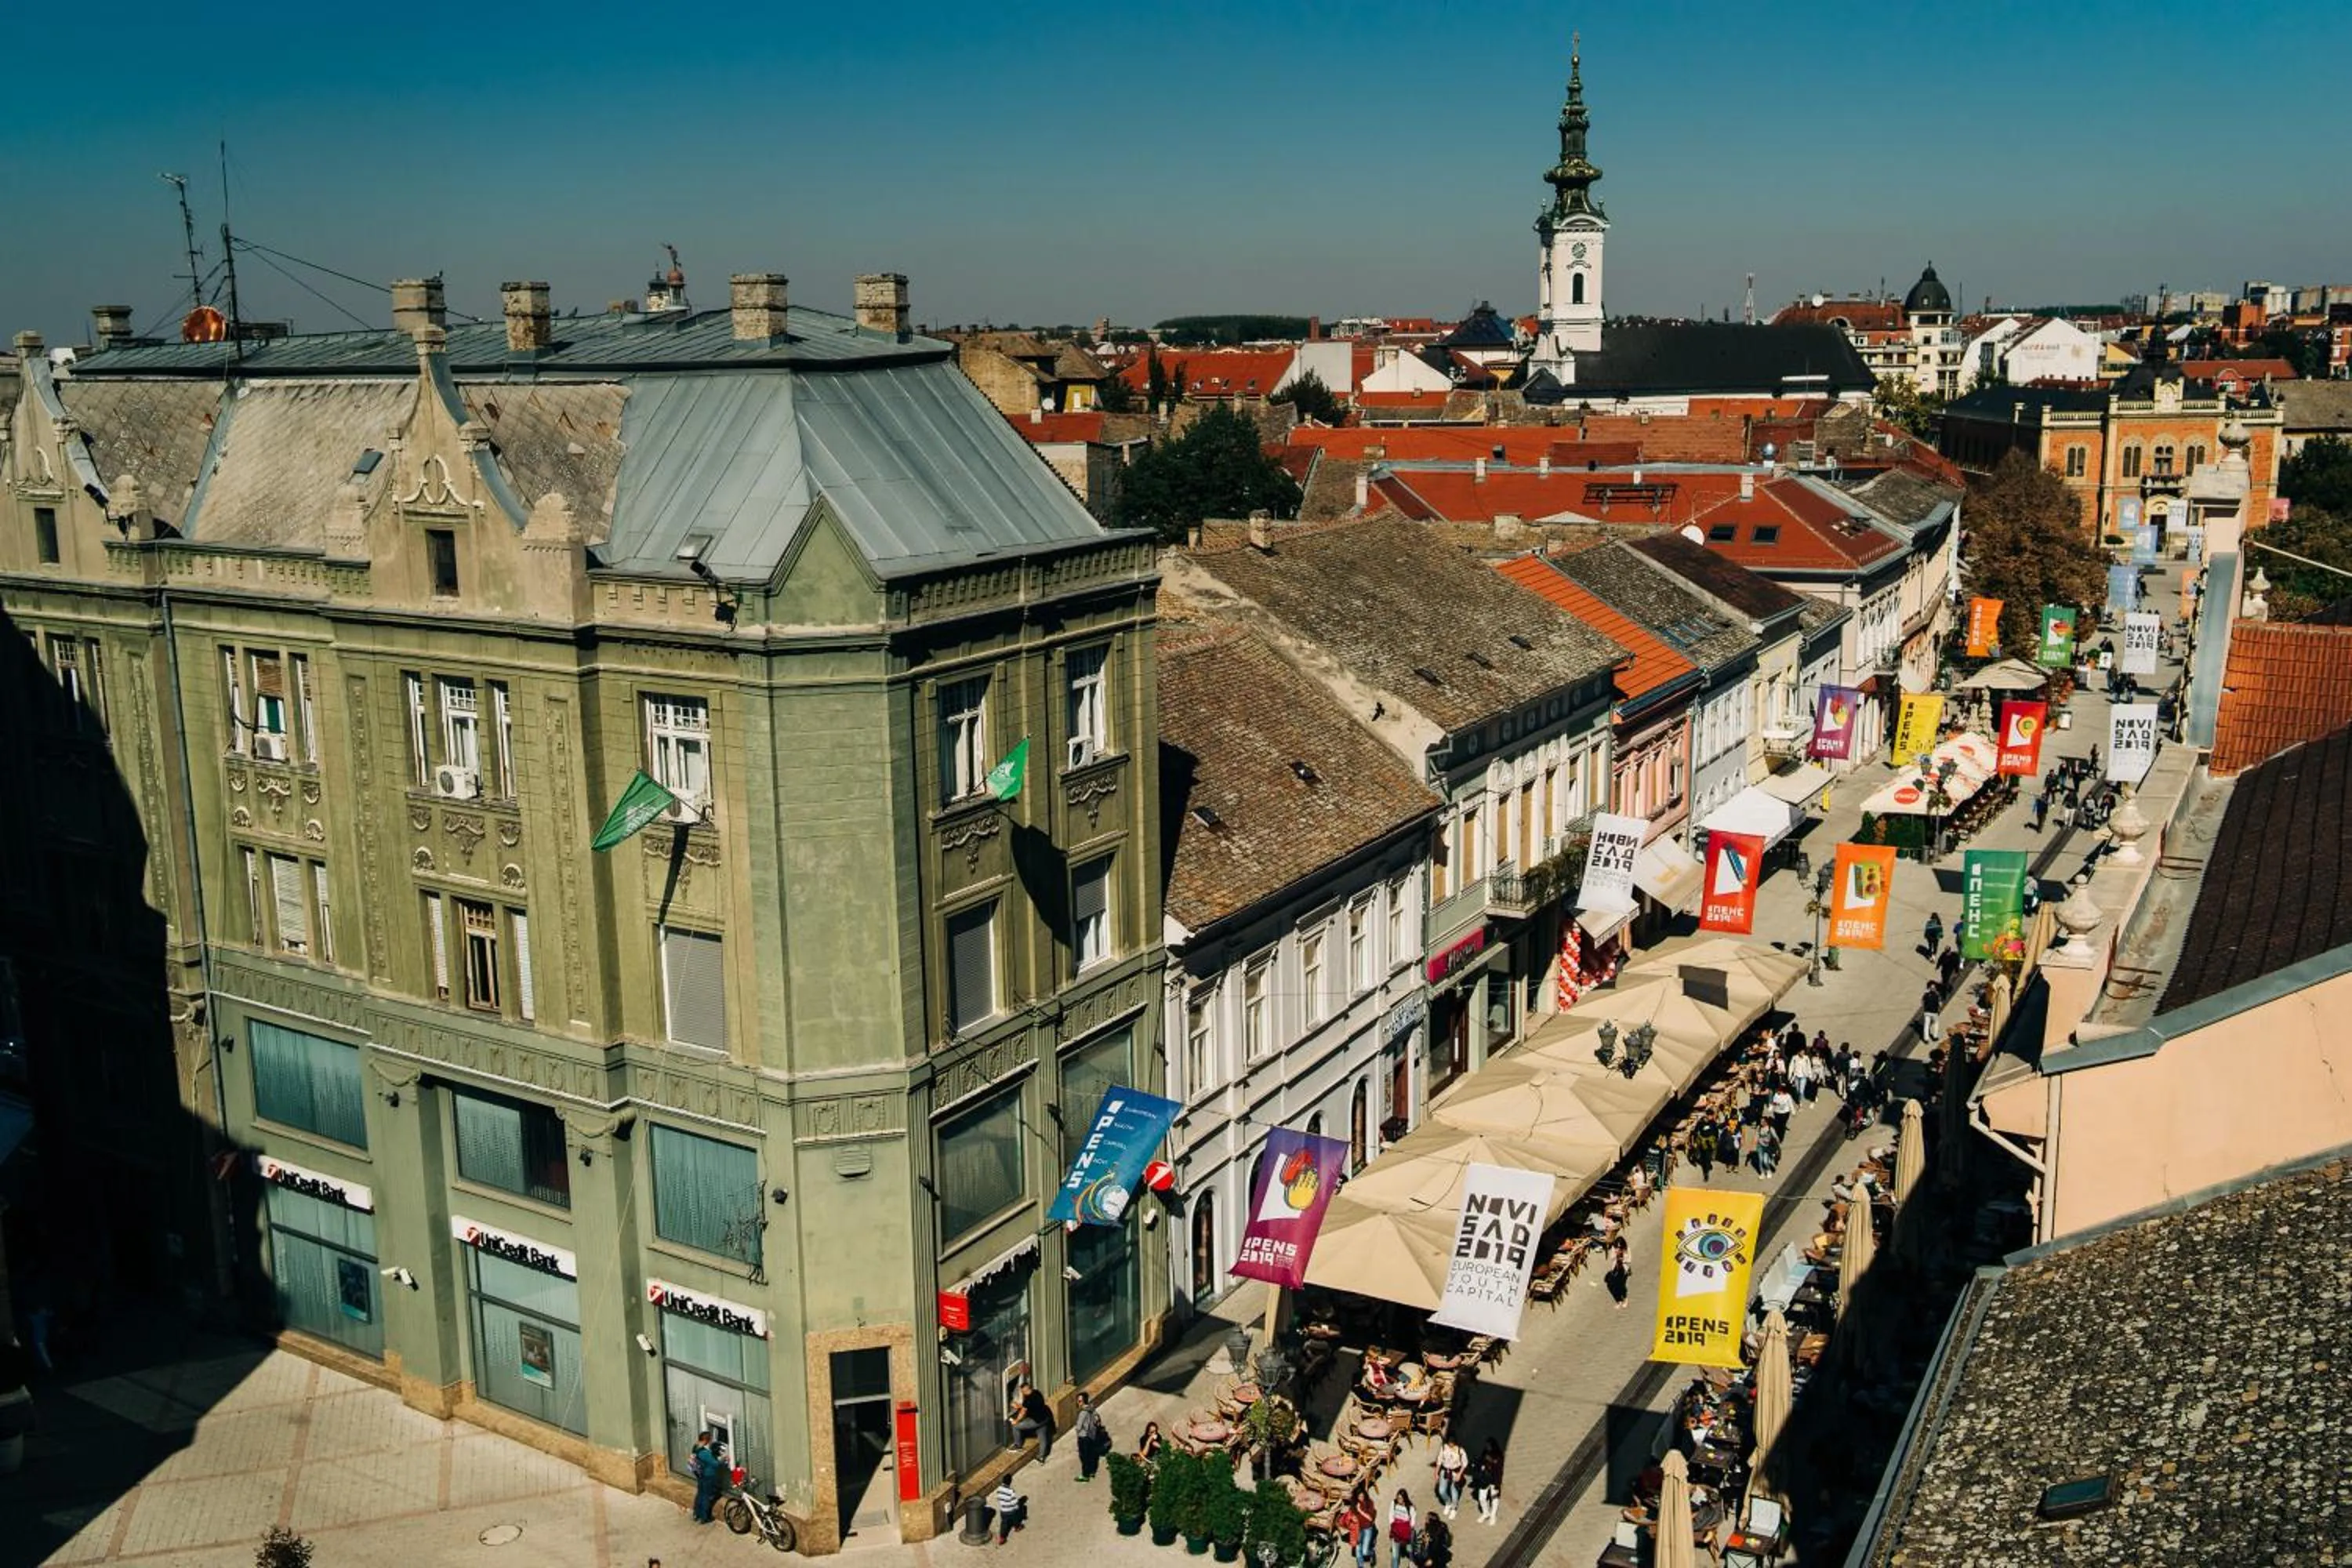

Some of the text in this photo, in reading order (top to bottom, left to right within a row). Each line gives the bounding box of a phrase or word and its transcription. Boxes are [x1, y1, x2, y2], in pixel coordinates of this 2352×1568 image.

[321, 1181, 347, 1203] Bank
[1465, 1193, 1537, 1225] NOVI
[1461, 1215, 1530, 1247] SAD
[480, 1232, 559, 1270] UniCredit Bank
[1240, 1249, 1275, 1266] 2019
[1455, 1238, 1527, 1270] 2019
[1452, 1260, 1521, 1283] EUROPEAN
[1446, 1283, 1515, 1308] CAPITAL
[1450, 1272, 1519, 1297] YOUTH
[665, 1291, 755, 1333] UniCredit Bank
[1664, 1330, 1705, 1346] 2019
